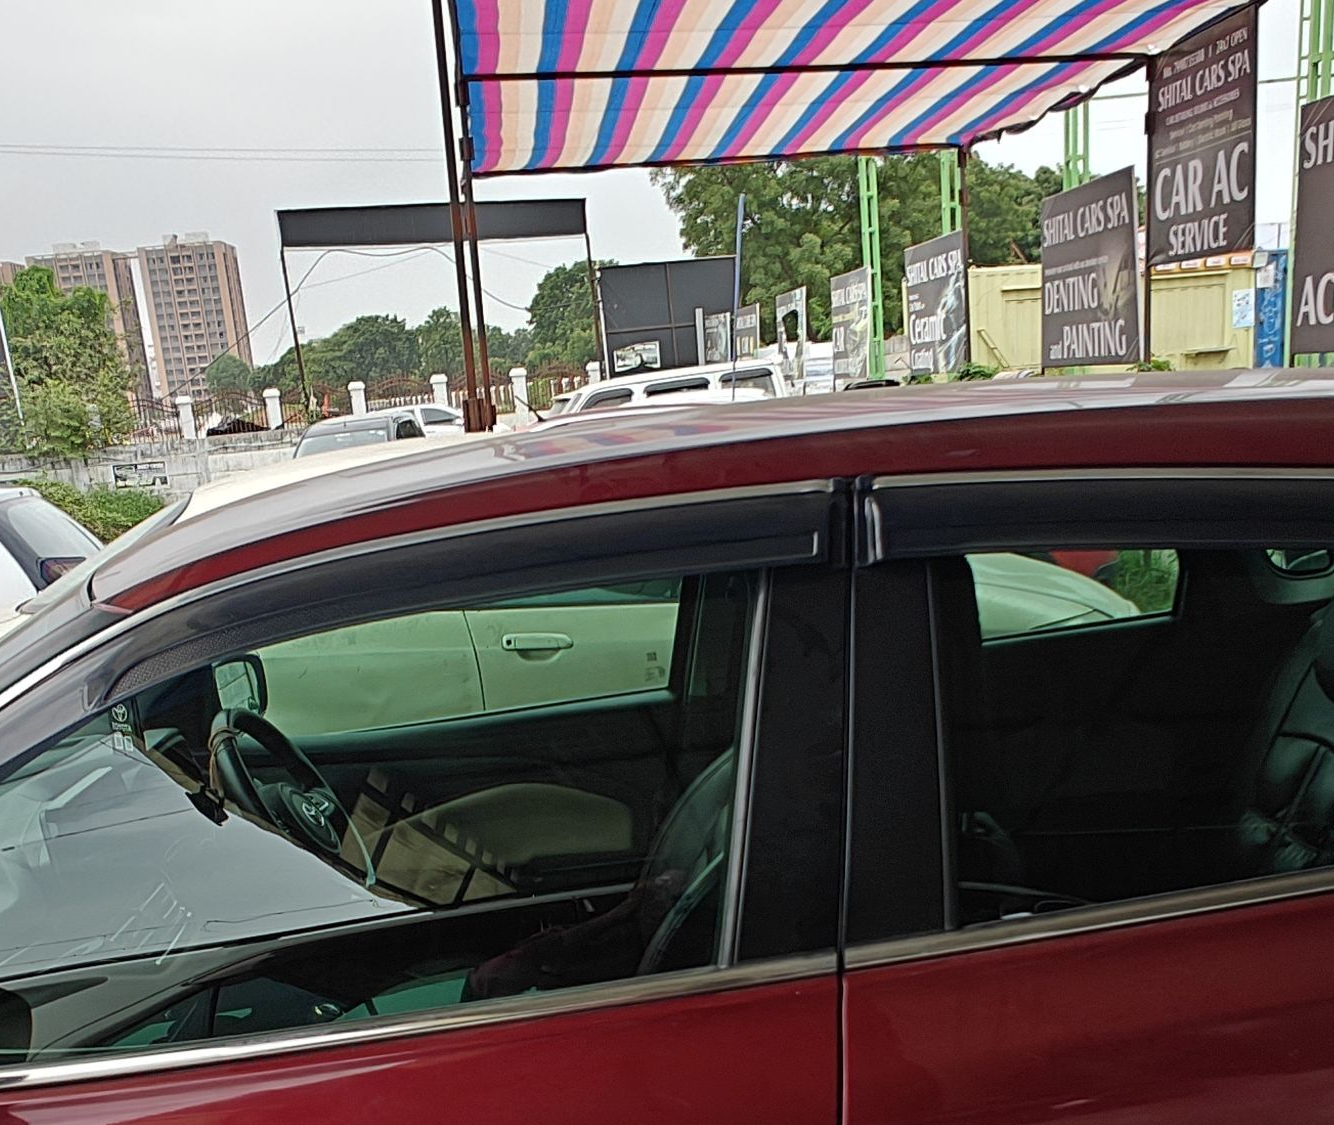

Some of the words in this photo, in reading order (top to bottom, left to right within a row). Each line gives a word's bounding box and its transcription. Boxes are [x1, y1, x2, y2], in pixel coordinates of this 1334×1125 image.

[1230, 27, 1248, 47] OPEN
[1158, 75, 1193, 112] SHITAL
[1195, 60, 1225, 96] CARS
[1228, 49, 1251, 82] SPA
[1155, 158, 1203, 221] CAR
[1210, 142, 1249, 208] AC
[1043, 211, 1075, 248] SHITAL
[1077, 200, 1104, 239] CARS
[1107, 191, 1130, 230] SPA
[1168, 213, 1228, 256] SERVICE
[906, 260, 929, 287] SHITAL
[929, 253, 947, 281] CARS
[1044, 272, 1099, 315] DENTING
[909, 314, 946, 345] Ceramic
[1050, 340, 1062, 360] and
[1063, 318, 1127, 359] PAINTING
